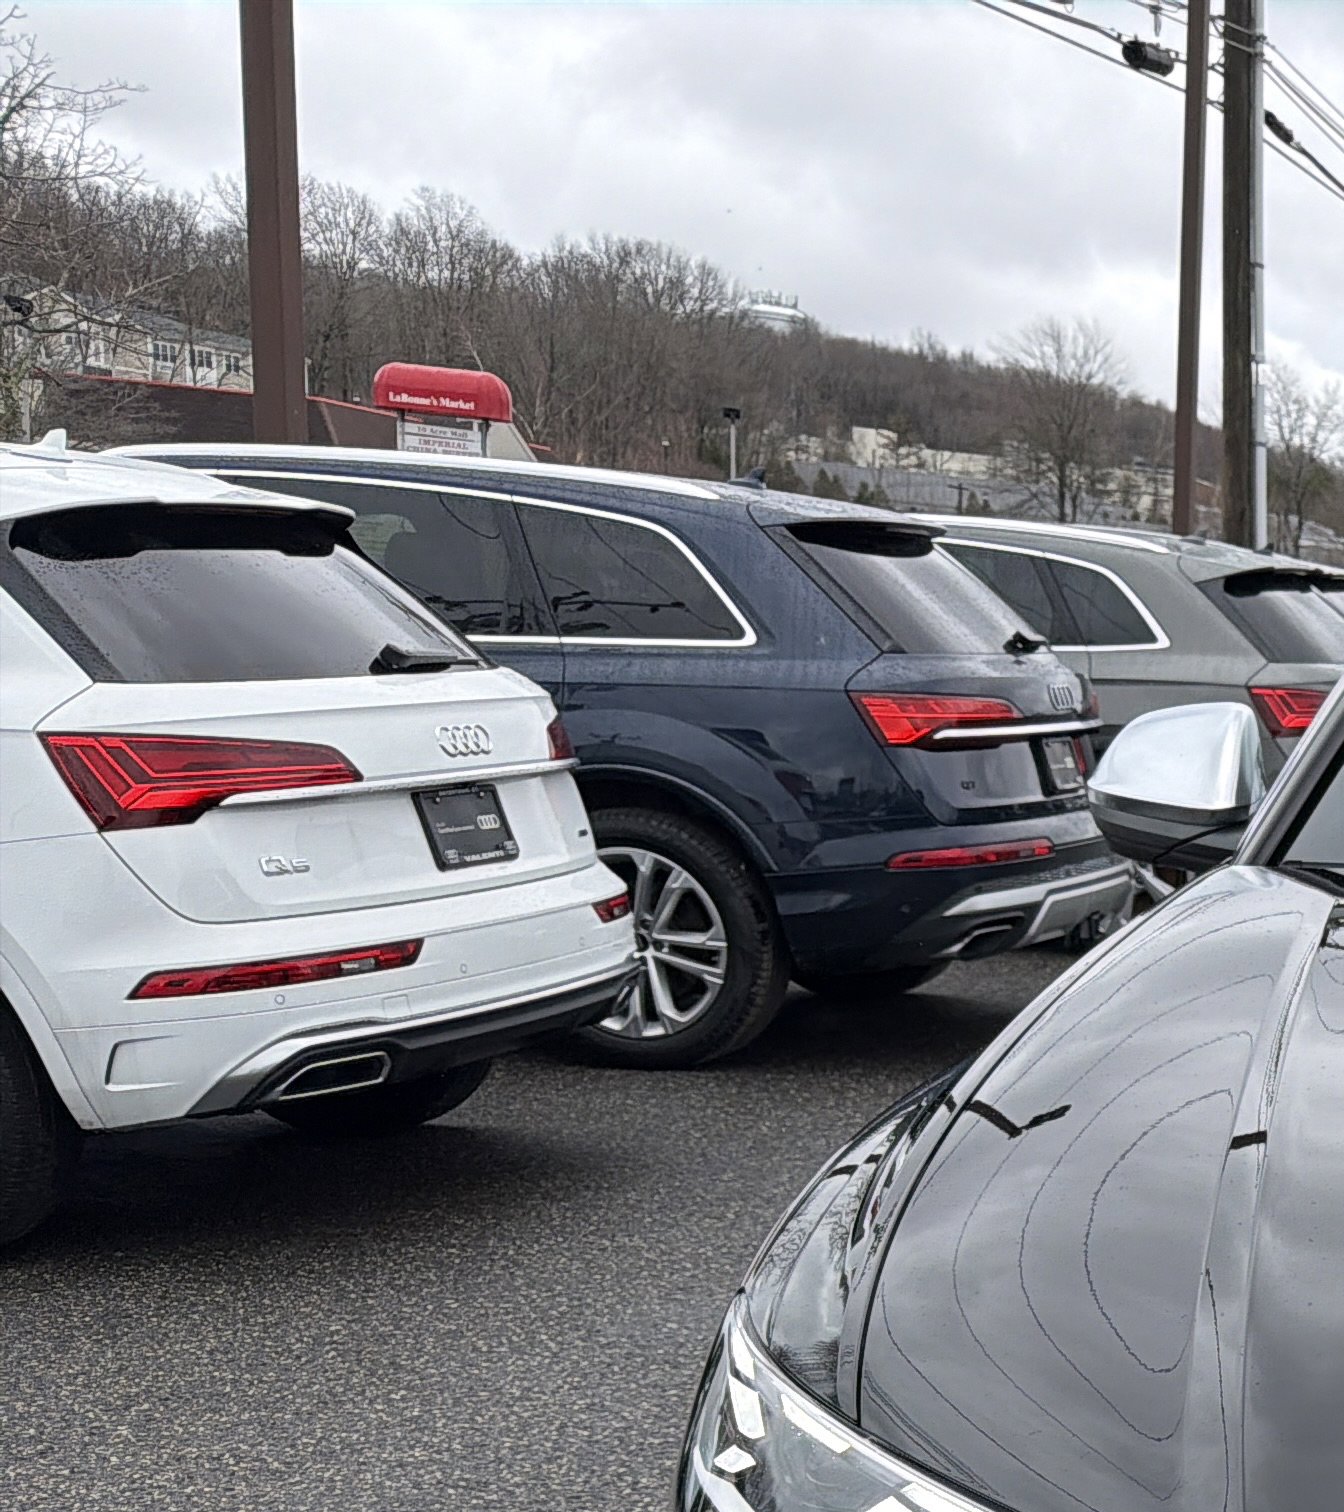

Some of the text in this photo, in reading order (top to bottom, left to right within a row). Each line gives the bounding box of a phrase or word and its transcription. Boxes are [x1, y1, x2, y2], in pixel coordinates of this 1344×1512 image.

[388, 391, 476, 411] LaBonne's Market
[258, 855, 311, 878] Q5
